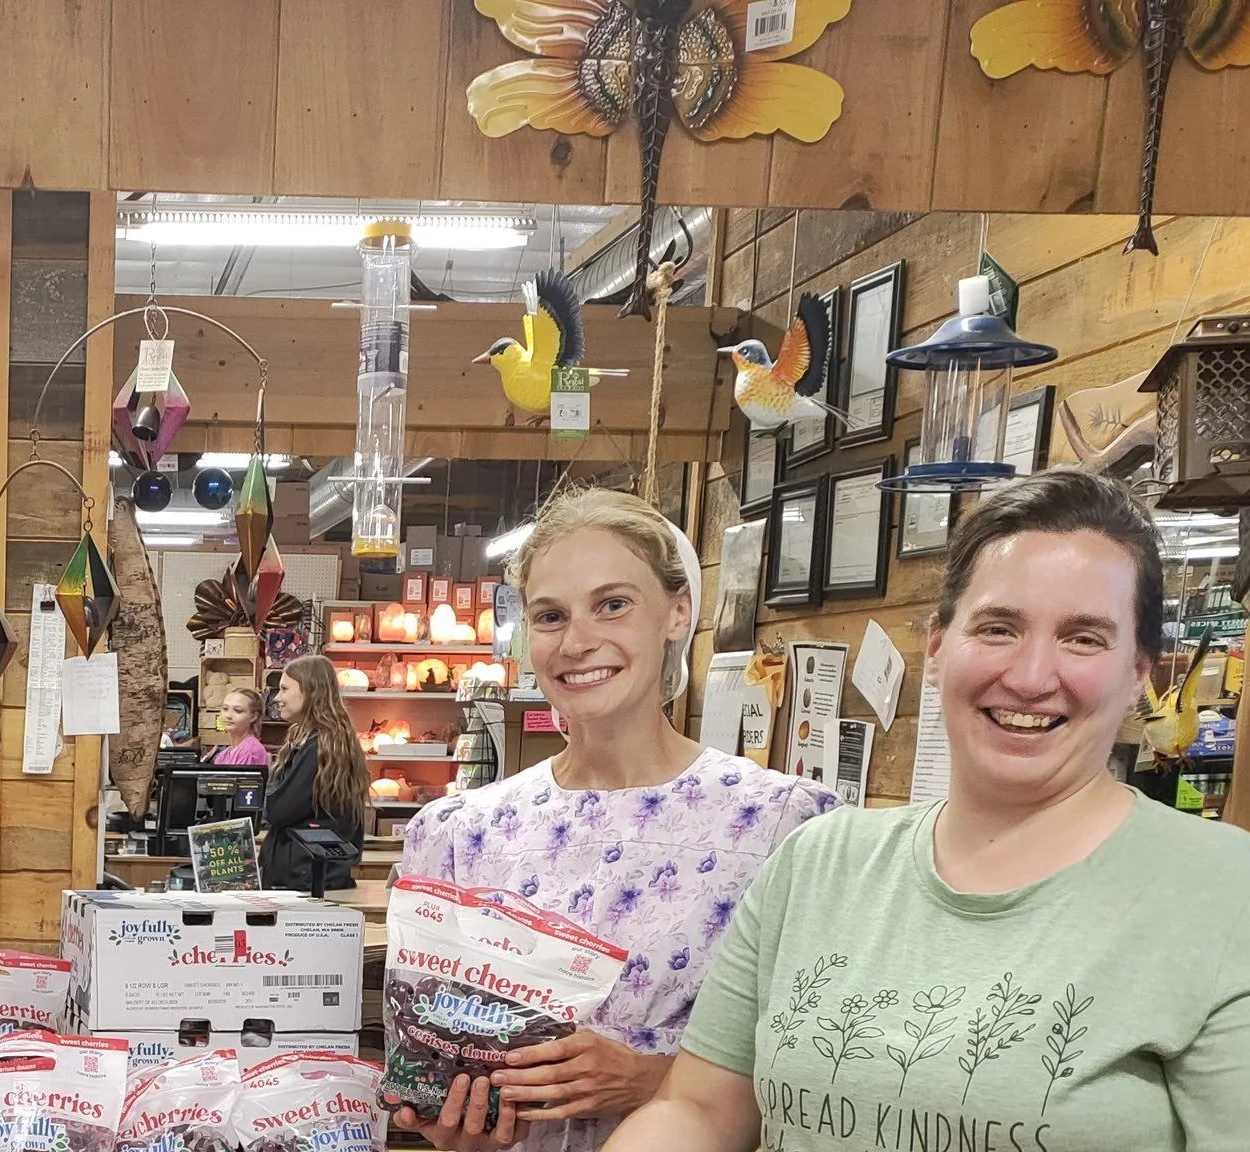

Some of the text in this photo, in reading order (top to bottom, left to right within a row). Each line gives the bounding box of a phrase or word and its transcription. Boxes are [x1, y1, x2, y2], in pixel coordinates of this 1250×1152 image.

[210, 845, 239, 858] 50 %
[210, 857, 243, 868] OFF ALL
[210, 865, 244, 876] PLANTS
[411, 883, 432, 894] sweet
[414, 907, 444, 923] 4045
[118, 919, 176, 938] joyfully
[137, 936, 165, 945] grown
[554, 929, 611, 953] sweet cherries
[586, 947, 601, 959] story
[397, 948, 578, 1022] sweet cherries
[429, 987, 520, 1031] joyfully
[452, 1018, 496, 1036] grown
[60, 1038, 109, 1048] sweet cherries
[408, 1026, 460, 1056] cerises
[132, 1058, 160, 1067] grown
[250, 1077, 280, 1090] 4045
[253, 1097, 321, 1133] sweet
[759, 1077, 857, 1139] SPREAD
[136, 1103, 223, 1135] cherries
